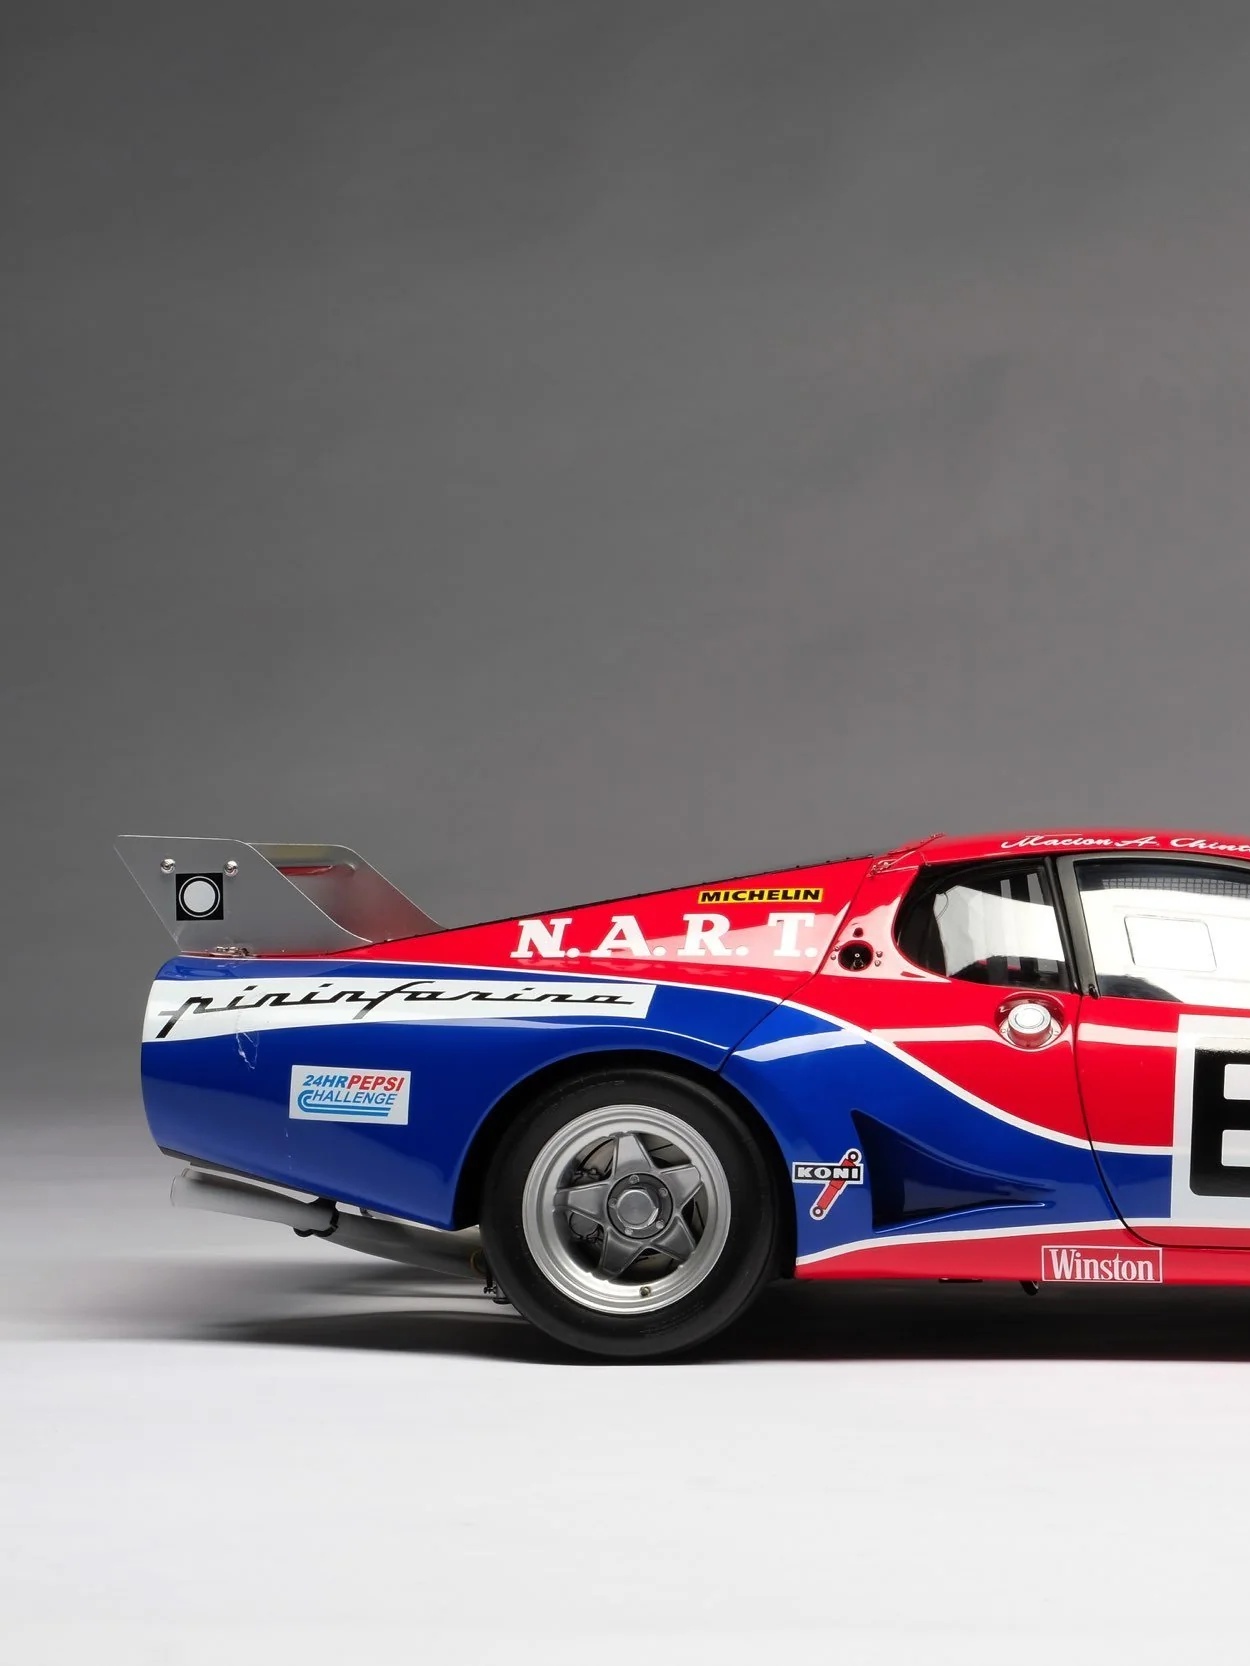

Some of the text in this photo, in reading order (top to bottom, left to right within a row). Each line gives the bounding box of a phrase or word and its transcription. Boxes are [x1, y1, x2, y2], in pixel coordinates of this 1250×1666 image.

[700, 889, 821, 903] MICHELIN
[156, 981, 636, 1039] pininfarina
[298, 1090, 398, 1110] CHALLENGE
[797, 1167, 859, 1179] KONI
[1049, 1249, 1155, 1281] Winston
